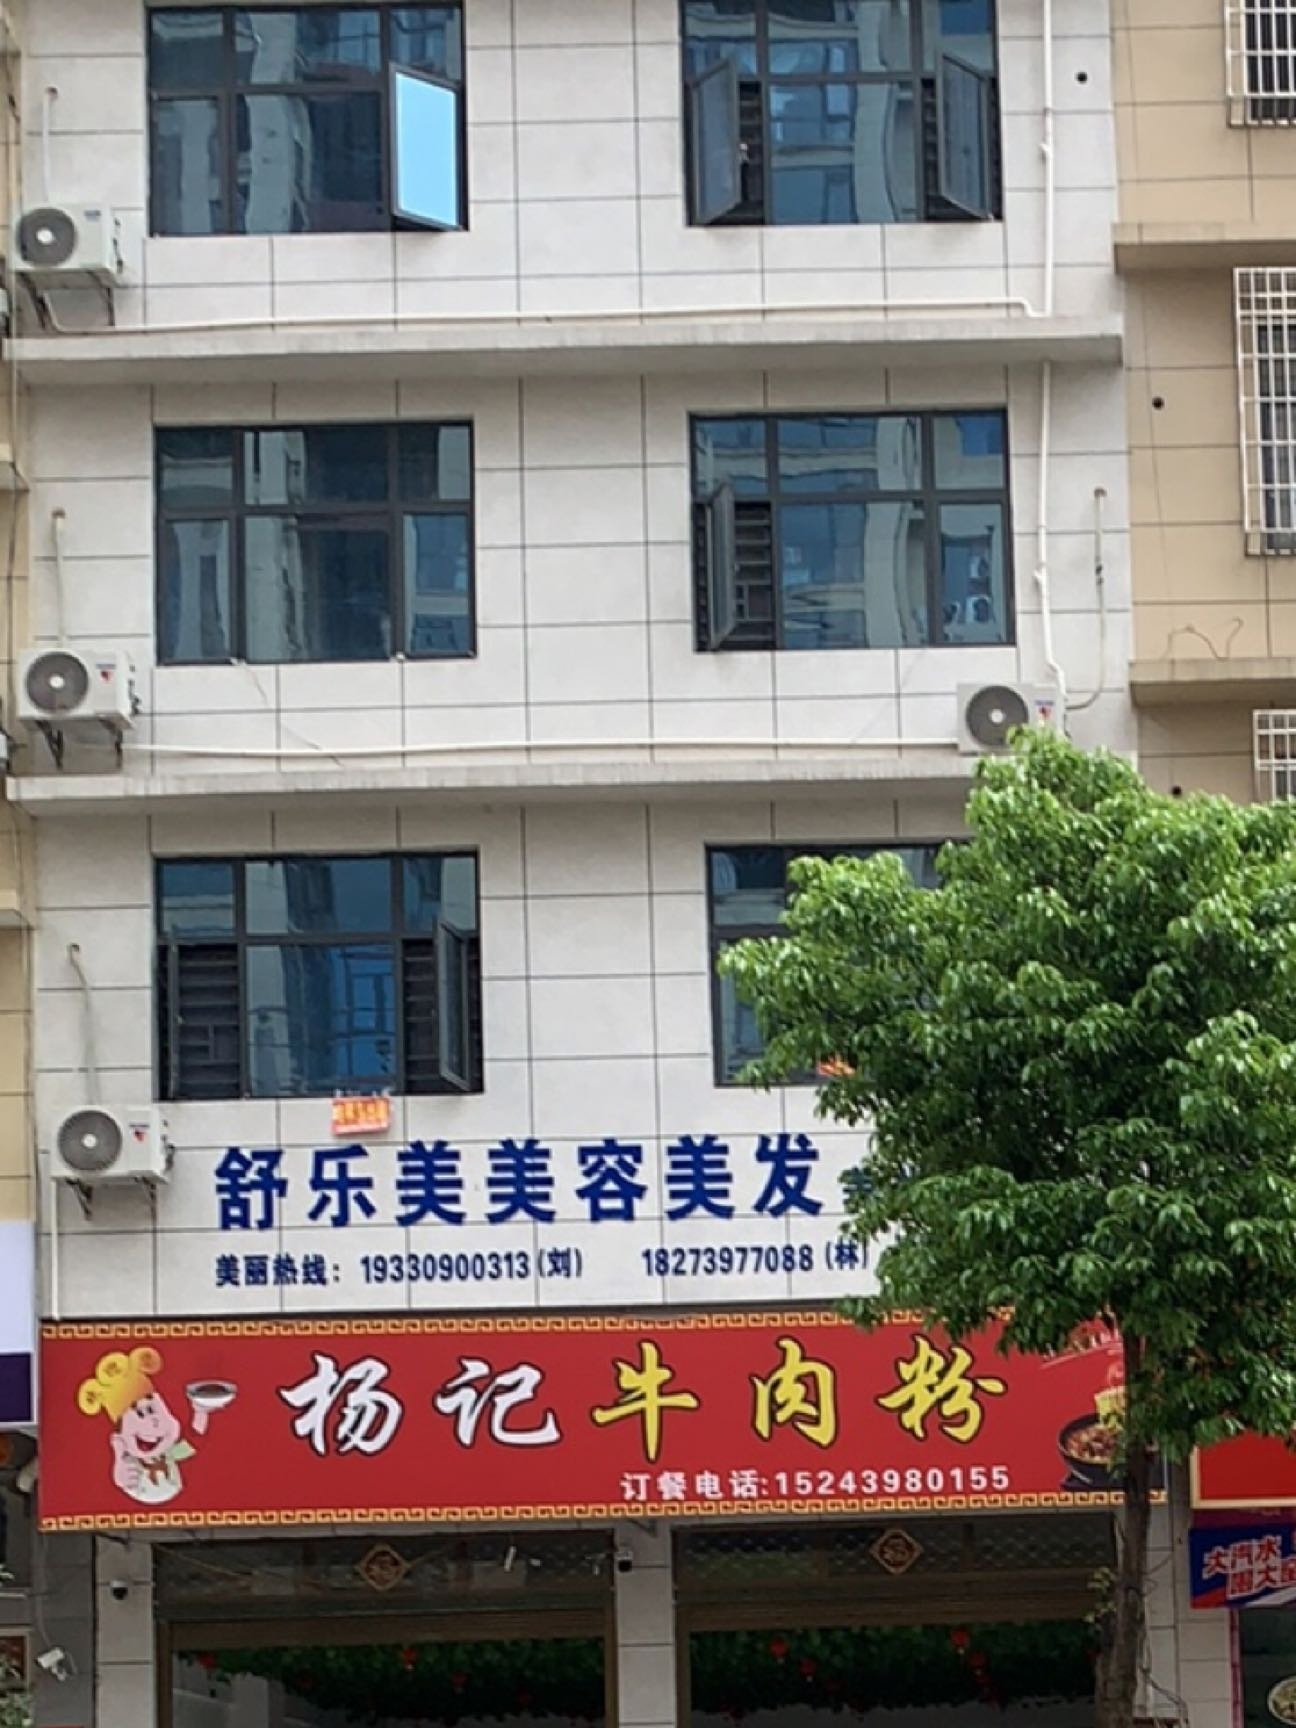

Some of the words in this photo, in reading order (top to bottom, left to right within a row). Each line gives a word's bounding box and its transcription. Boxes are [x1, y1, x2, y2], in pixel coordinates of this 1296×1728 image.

[214, 1133, 824, 1231] 舒乐美美容美发
[280, 1335, 1005, 1463] 杨记牛肉粉
